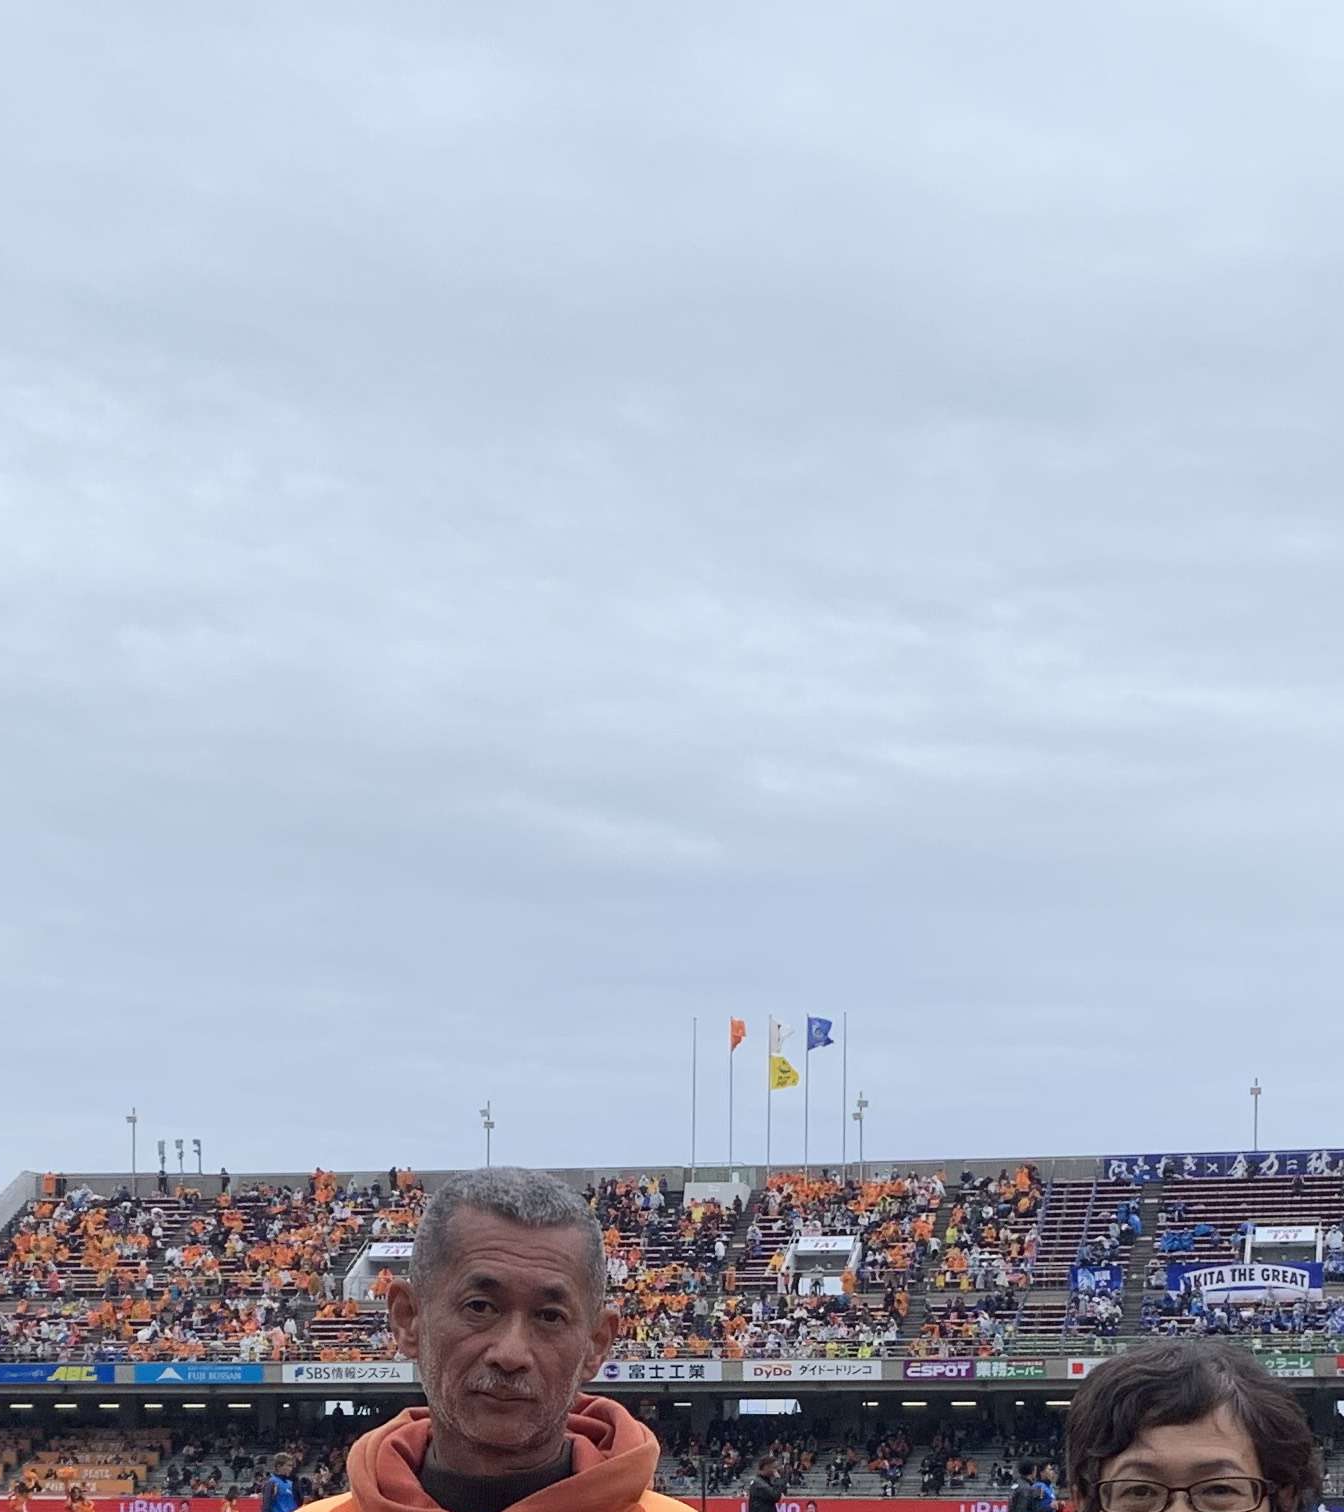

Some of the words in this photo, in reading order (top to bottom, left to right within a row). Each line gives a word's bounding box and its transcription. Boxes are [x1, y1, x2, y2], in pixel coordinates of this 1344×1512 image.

[1230, 1267, 1256, 1284] THE
[1260, 1267, 1307, 1287] GREAT
[306, 1366, 401, 1380] SBS情報システム
[628, 1364, 706, 1380] 富士工業
[753, 1366, 793, 1379] DyDo
[799, 1365, 873, 1377] ダイドードリンコ
[906, 1361, 971, 1377] ESPOT
[975, 1361, 1044, 1377] 業務スーパー
